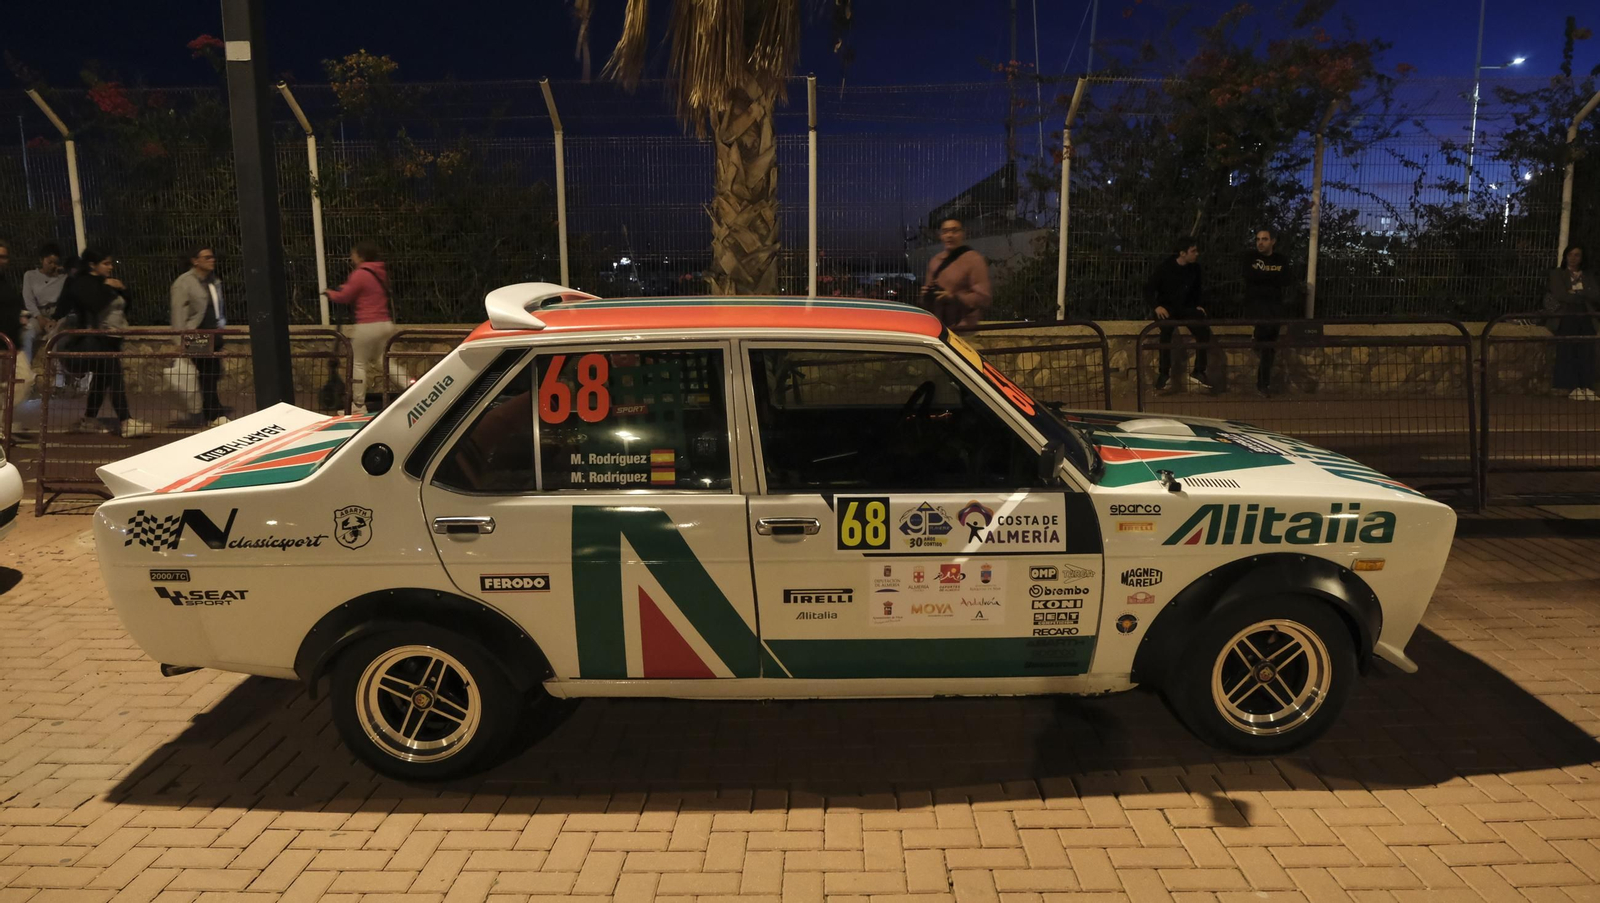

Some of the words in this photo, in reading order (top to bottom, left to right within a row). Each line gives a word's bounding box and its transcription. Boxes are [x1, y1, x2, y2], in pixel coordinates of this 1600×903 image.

[538, 352, 611, 425] 68
[983, 361, 1037, 417] 68
[407, 375, 455, 429] Alitalia
[615, 405, 646, 414] SPORT
[226, 423, 287, 449] ABARTH
[570, 454, 585, 466] M.
[588, 452, 648, 467] Rodríguez
[570, 472, 586, 484] M.
[588, 471, 648, 486] Rodríguez
[340, 507, 368, 517] ABARTH
[1109, 503, 1162, 516] sparco
[841, 501, 887, 547] 68
[997, 515, 1041, 527] COSTA
[1041, 515, 1060, 526] DE
[1162, 502, 1397, 546] Alitalia
[985, 525, 1061, 545] ALMERÍA
[228, 533, 329, 553] classicsport
[909, 537, 923, 549] 30
[151, 572, 187, 581] 2000/TC
[1031, 568, 1057, 579] OMP
[1120, 566, 1163, 580] MAGNETI
[484, 577, 546, 590] FERODO
[188, 590, 249, 600] SEAT
[783, 588, 854, 604] PIRELLI
[1044, 586, 1089, 596] brembo
[910, 603, 954, 615] MOYA
[1033, 599, 1082, 610] KONI
[795, 610, 839, 621] Alitalia
[1033, 611, 1080, 621] SEAT
[1033, 627, 1079, 637] RECARO
